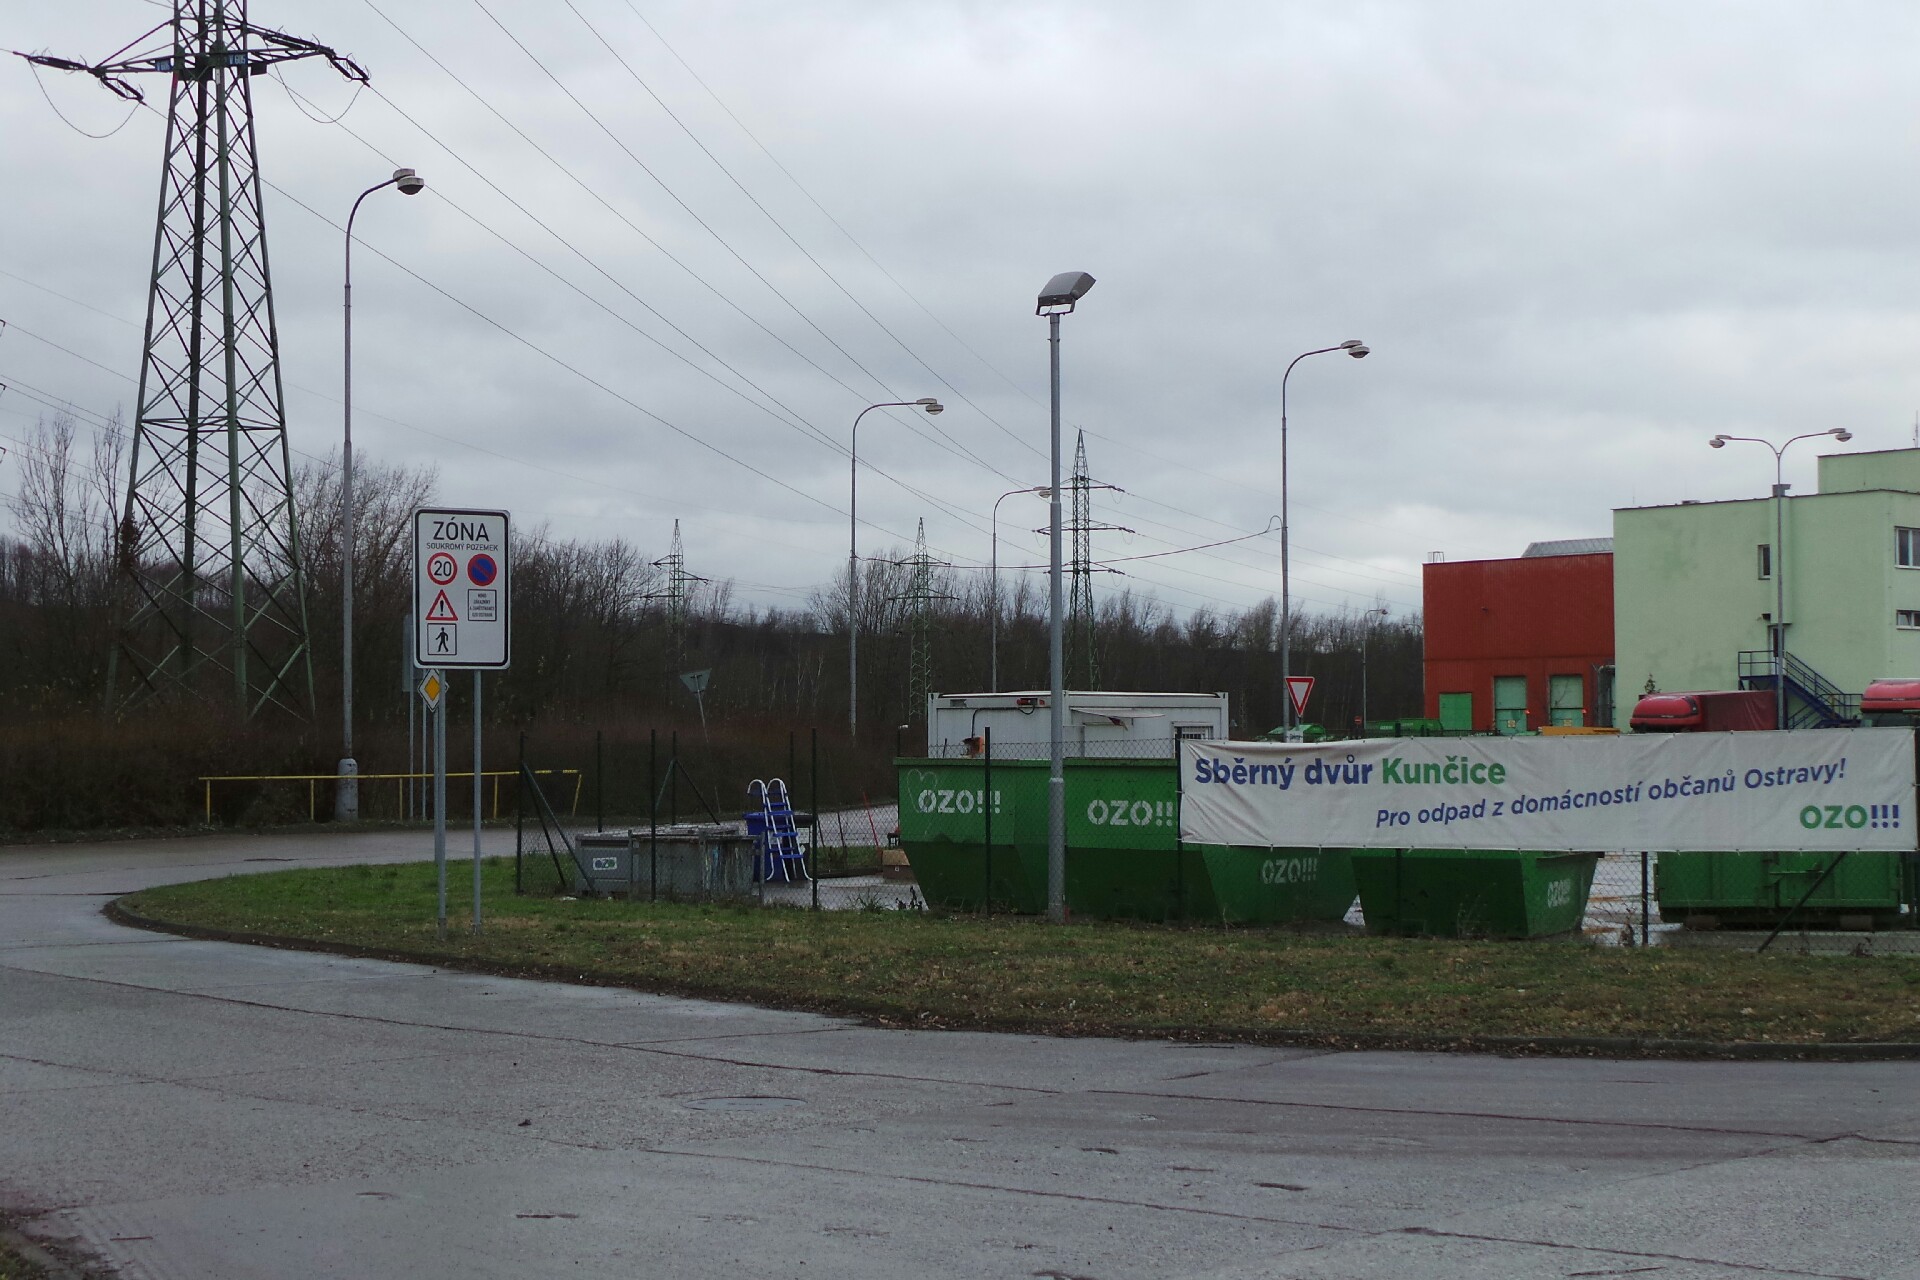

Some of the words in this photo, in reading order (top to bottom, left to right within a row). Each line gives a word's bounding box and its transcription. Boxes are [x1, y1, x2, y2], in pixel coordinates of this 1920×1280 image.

[433, 517, 489, 541] ZÓNA
[467, 543, 498, 551] POZEMEK
[434, 561, 452, 577] 20
[1194, 756, 1296, 791] Sběrný
[1304, 754, 1373, 785] dvůr
[1382, 755, 1506, 785] Kunčice
[917, 789, 1001, 814] OZO!!
[1376, 808, 1411, 828] Pro
[1417, 798, 1486, 825] odpad
[1491, 800, 1504, 816] z
[1511, 780, 1645, 815] domácností
[1648, 768, 1736, 801] občanů
[1744, 757, 1847, 789] Ostravy!
[1799, 804, 1900, 829] OZO!!!
[1261, 857, 1318, 884] OZO!!!
